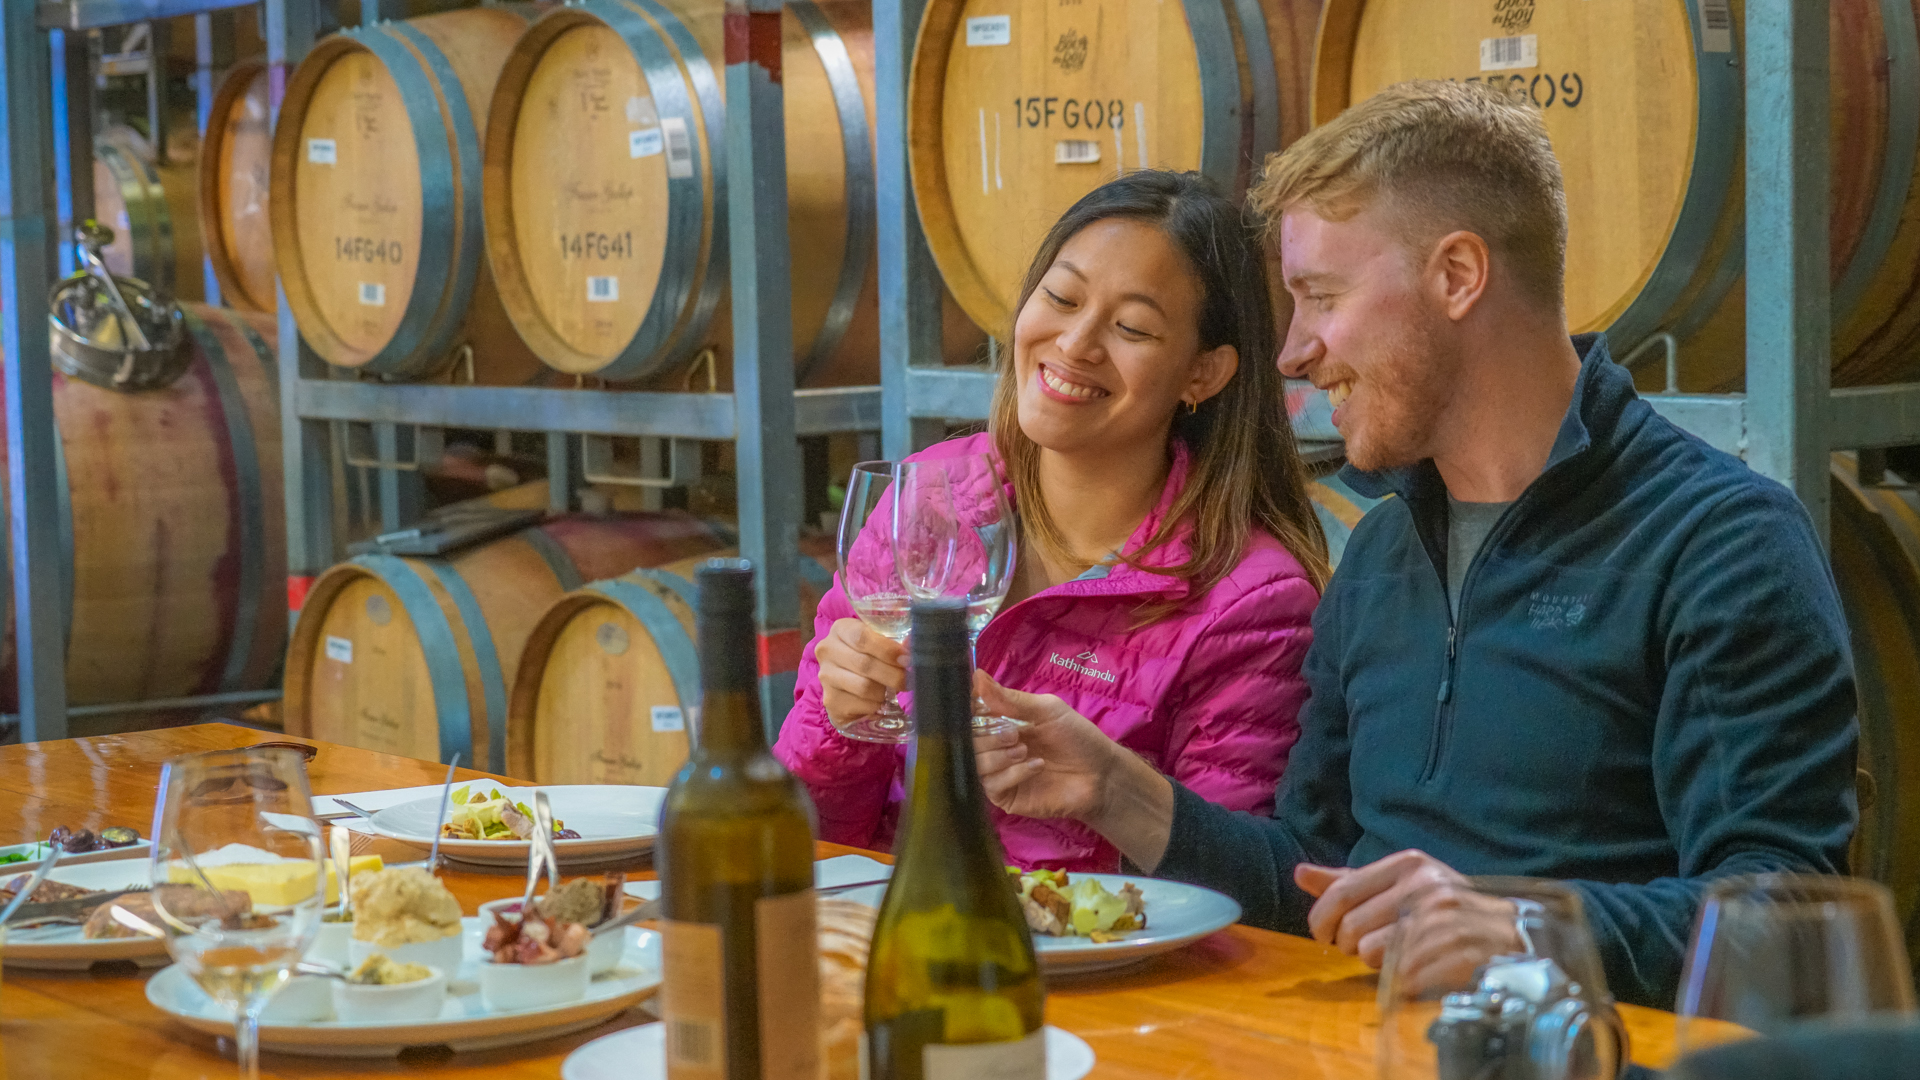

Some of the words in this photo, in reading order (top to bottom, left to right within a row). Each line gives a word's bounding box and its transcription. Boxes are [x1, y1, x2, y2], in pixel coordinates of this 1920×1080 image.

[1014, 96, 1125, 130] 15FG08
[334, 235, 403, 265] 14FG40
[560, 230, 633, 261] 14FG41
[1049, 651, 1116, 683] Kathmandu
